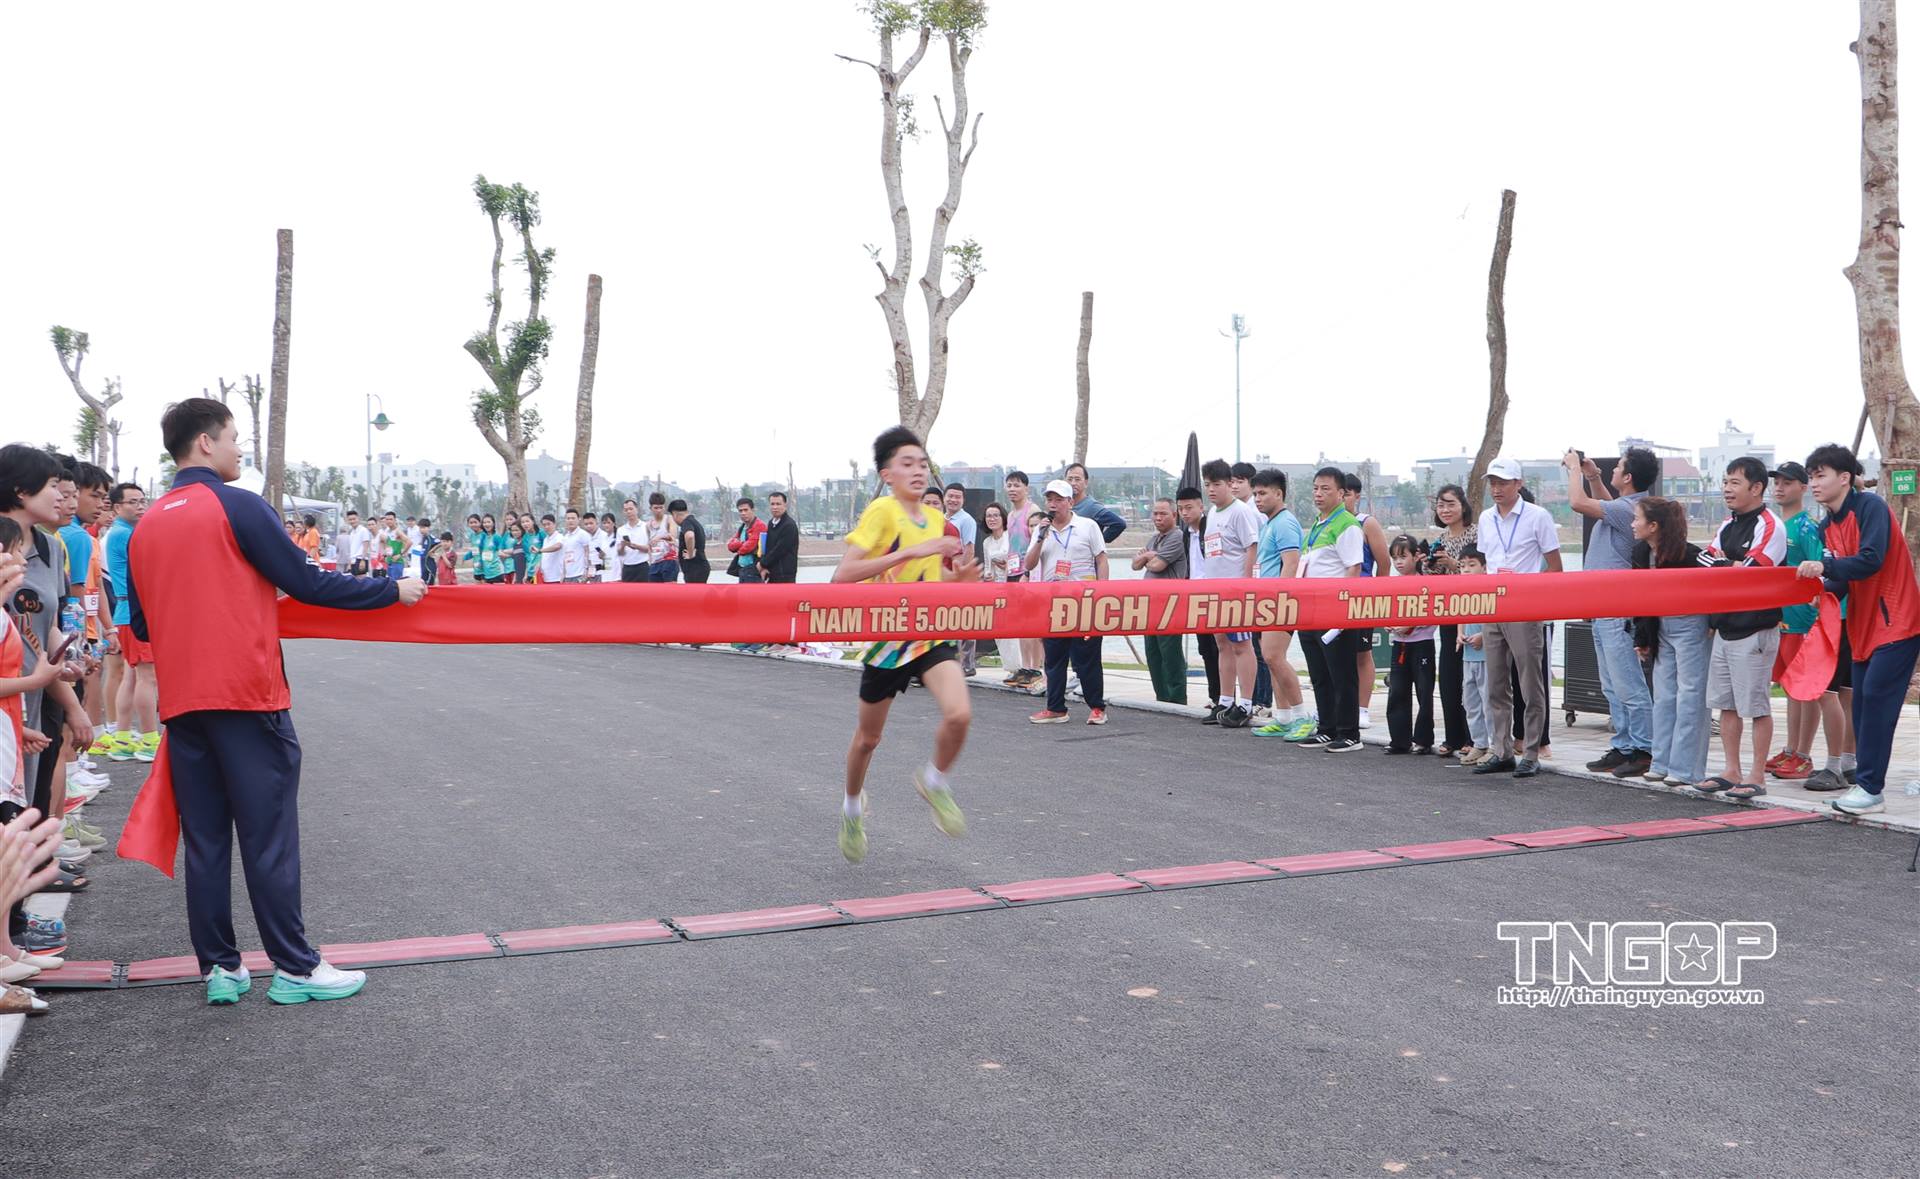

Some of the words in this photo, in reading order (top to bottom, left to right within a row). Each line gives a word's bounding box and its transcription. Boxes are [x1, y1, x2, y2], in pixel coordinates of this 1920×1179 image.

[869, 598, 909, 632] TRẺ
[1049, 588, 1150, 633] ĐÍCH
[1156, 594, 1180, 631] /
[1186, 592, 1299, 629] Finish
[1396, 587, 1428, 618] TRẺ
